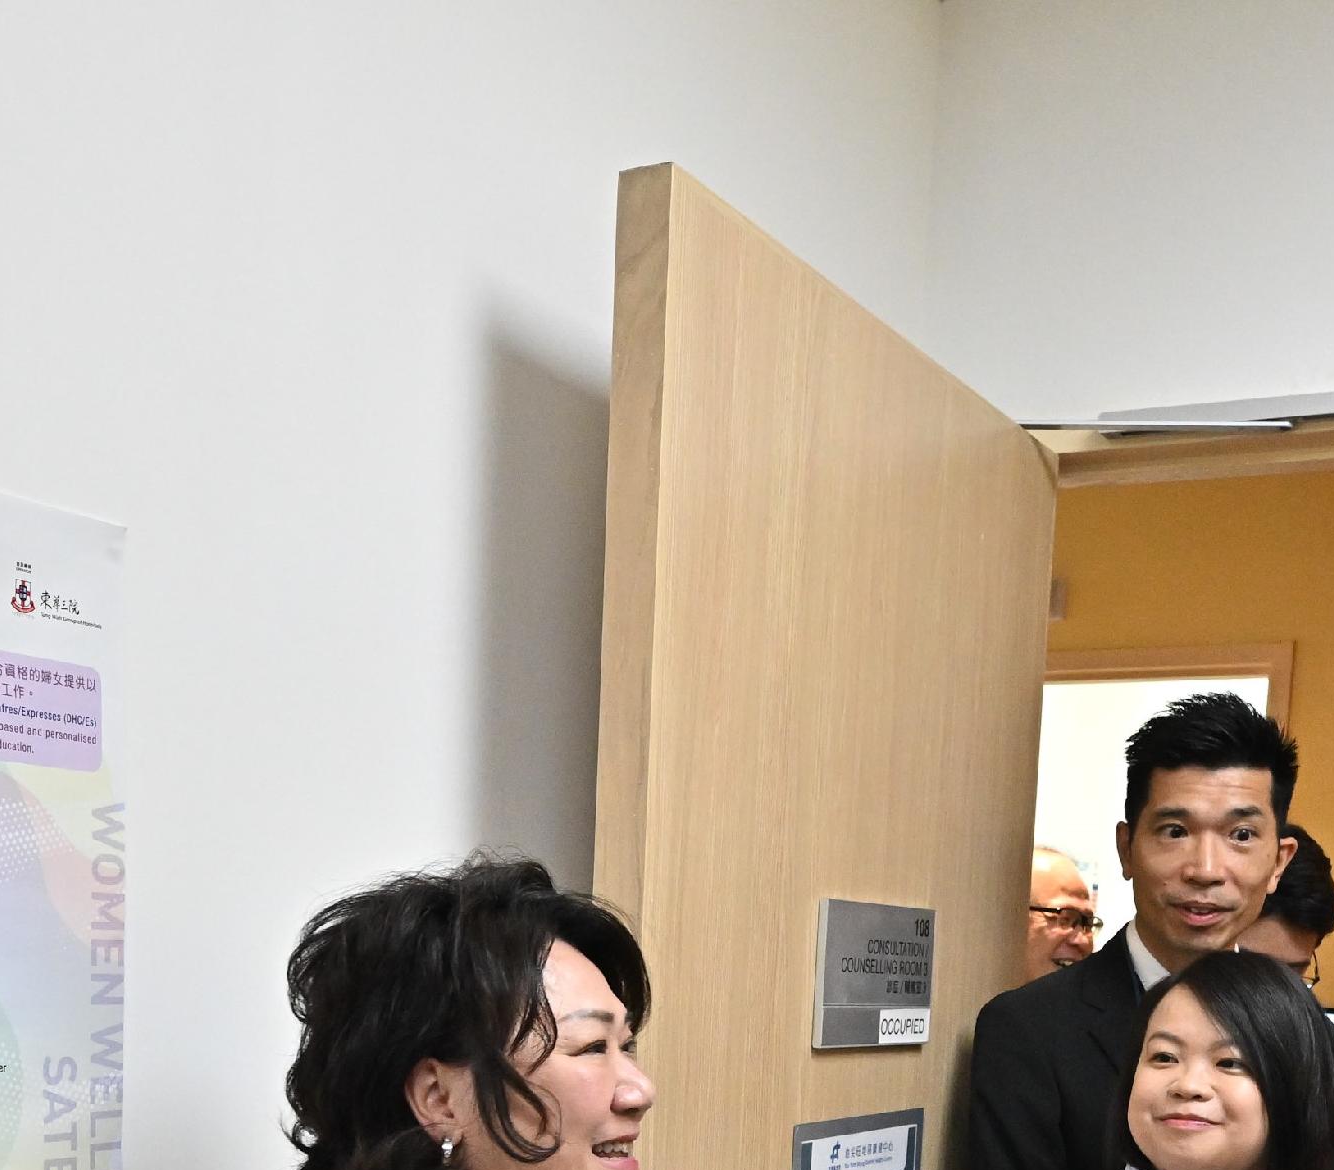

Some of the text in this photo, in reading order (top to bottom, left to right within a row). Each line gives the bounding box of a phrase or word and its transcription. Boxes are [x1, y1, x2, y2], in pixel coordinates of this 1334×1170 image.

[90, 802, 126, 1005] WOMEN
[915, 920, 929, 937] 108
[841, 958, 897, 975] COUNSELLING
[881, 1019, 924, 1035] OCCUPIED
